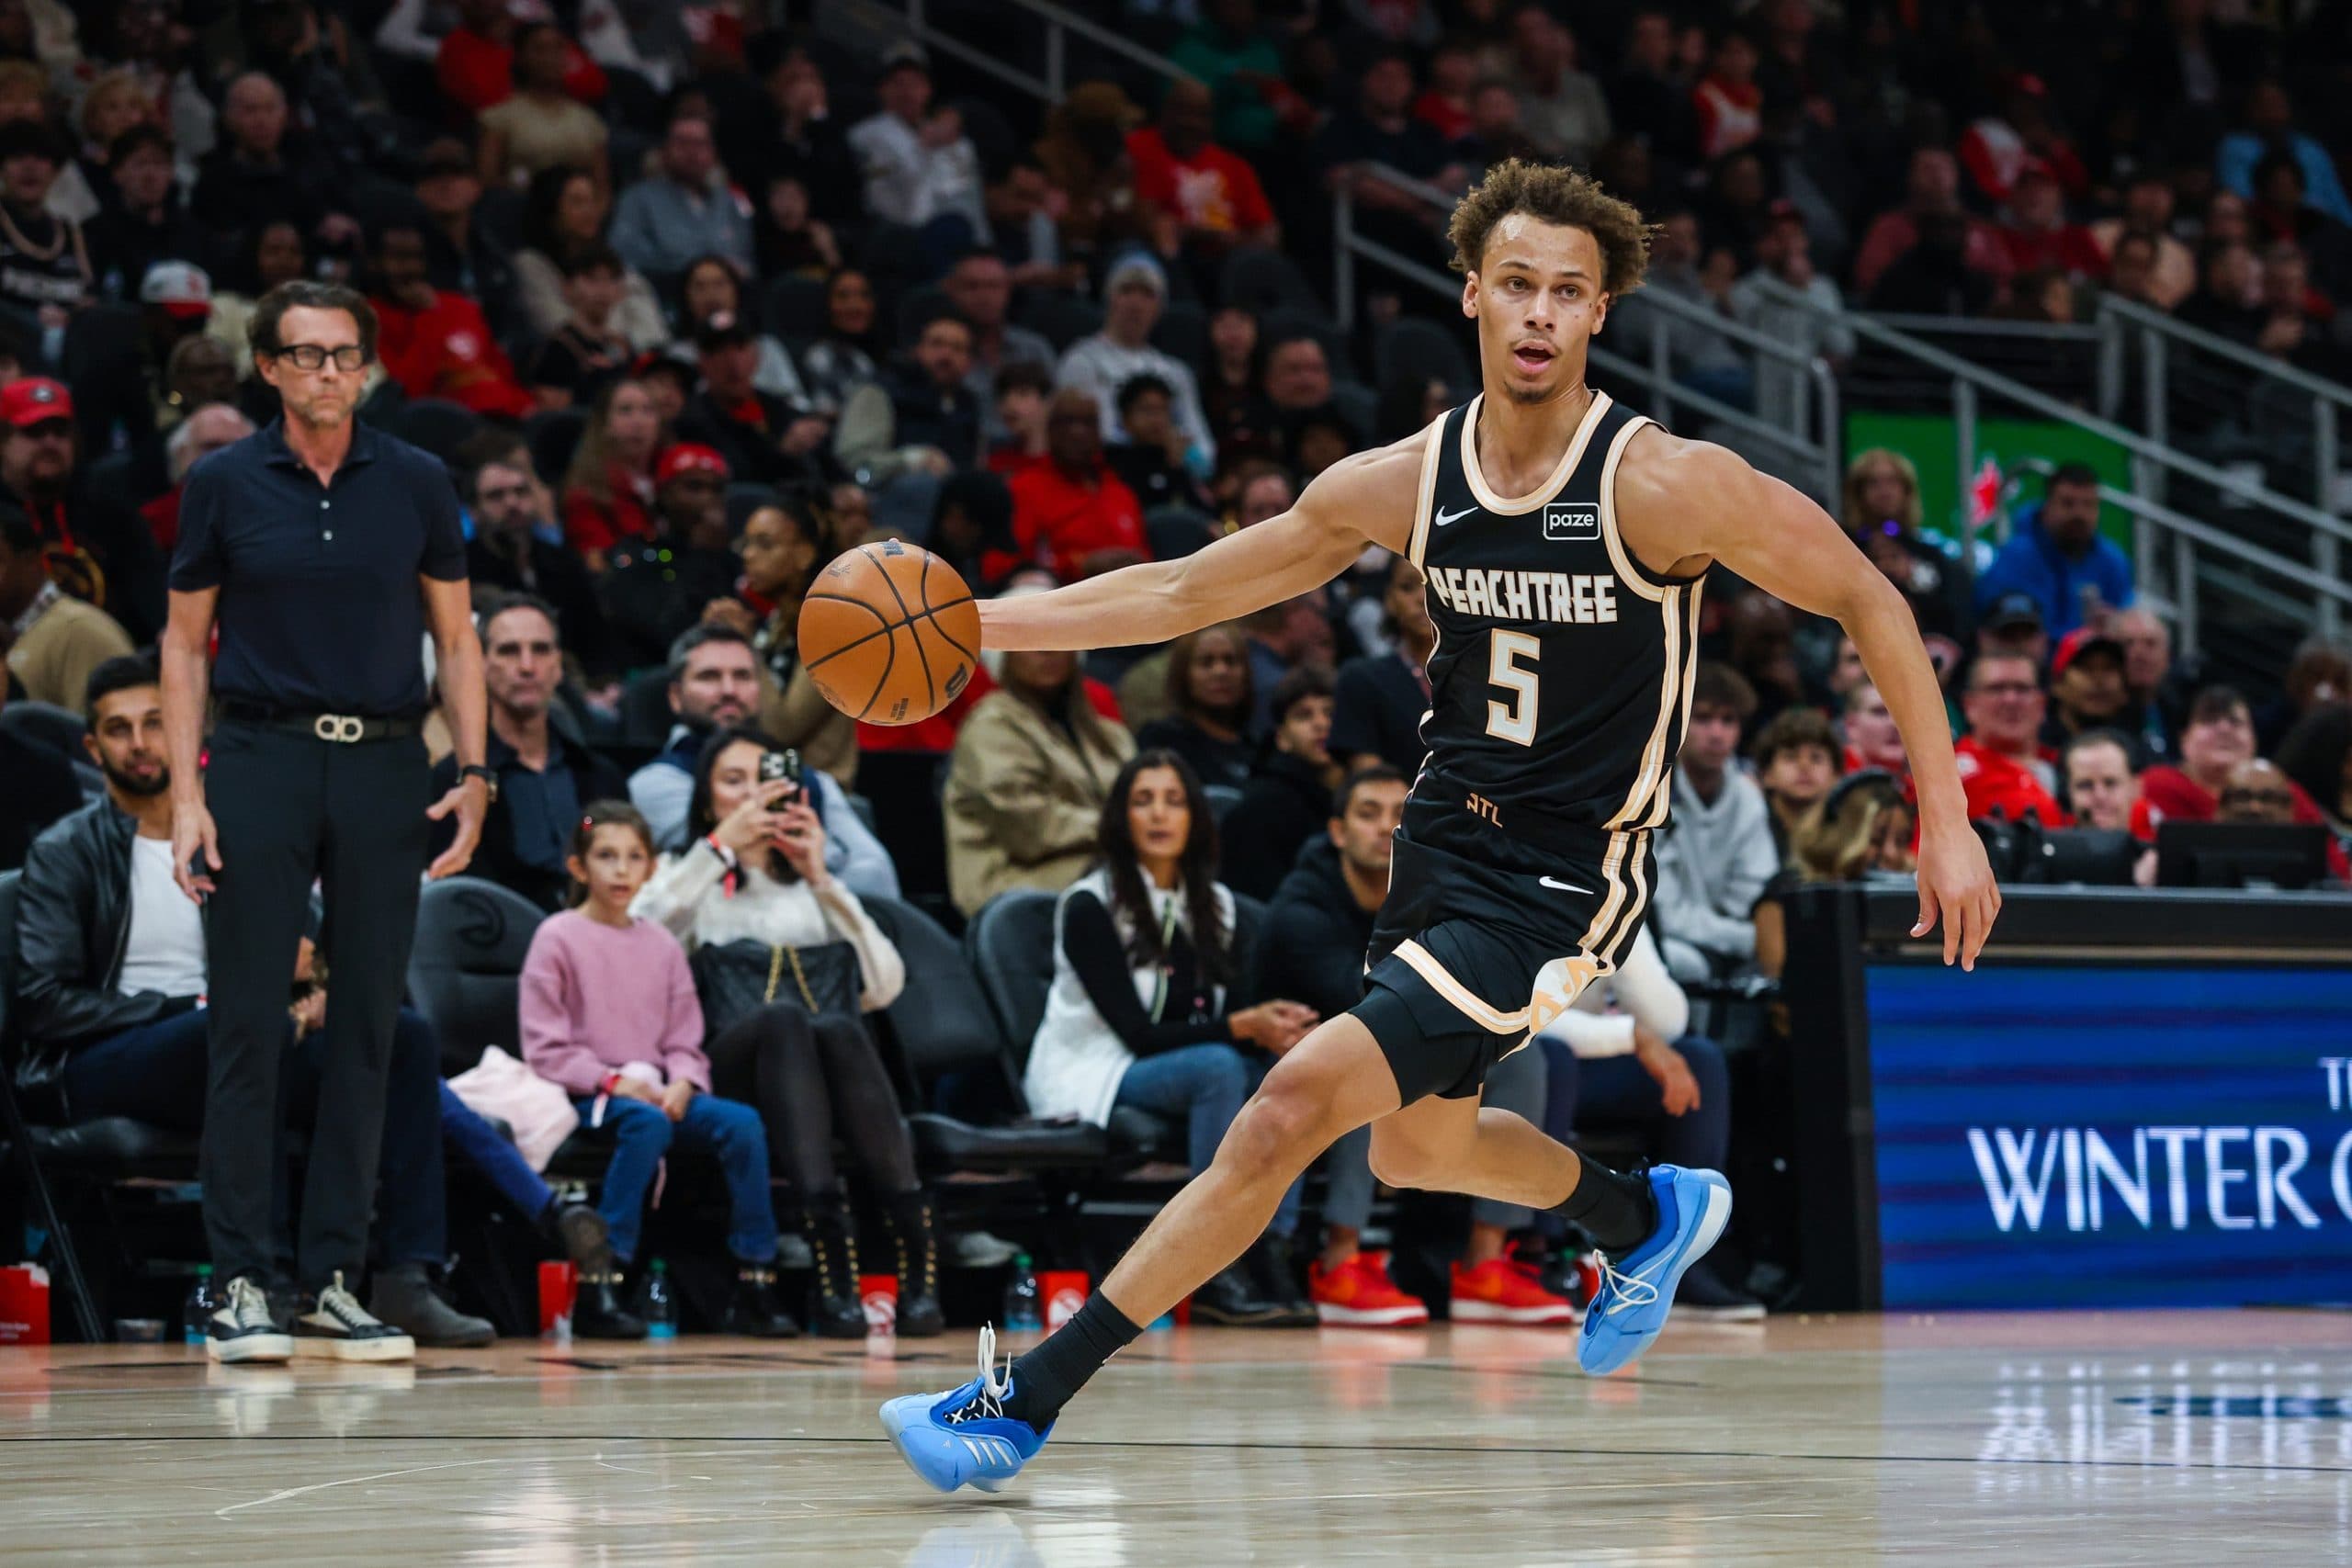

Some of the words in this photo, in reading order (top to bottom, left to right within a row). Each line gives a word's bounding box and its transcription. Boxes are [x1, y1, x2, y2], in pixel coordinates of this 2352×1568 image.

[1549, 513, 1595, 530] paze
[1427, 566, 1618, 624] PEACHTREE
[1485, 627, 1541, 748] 5
[1466, 792, 1503, 829] ATL
[2317, 1056, 2352, 1111] T
[1967, 1126, 2322, 1232] WINTER
